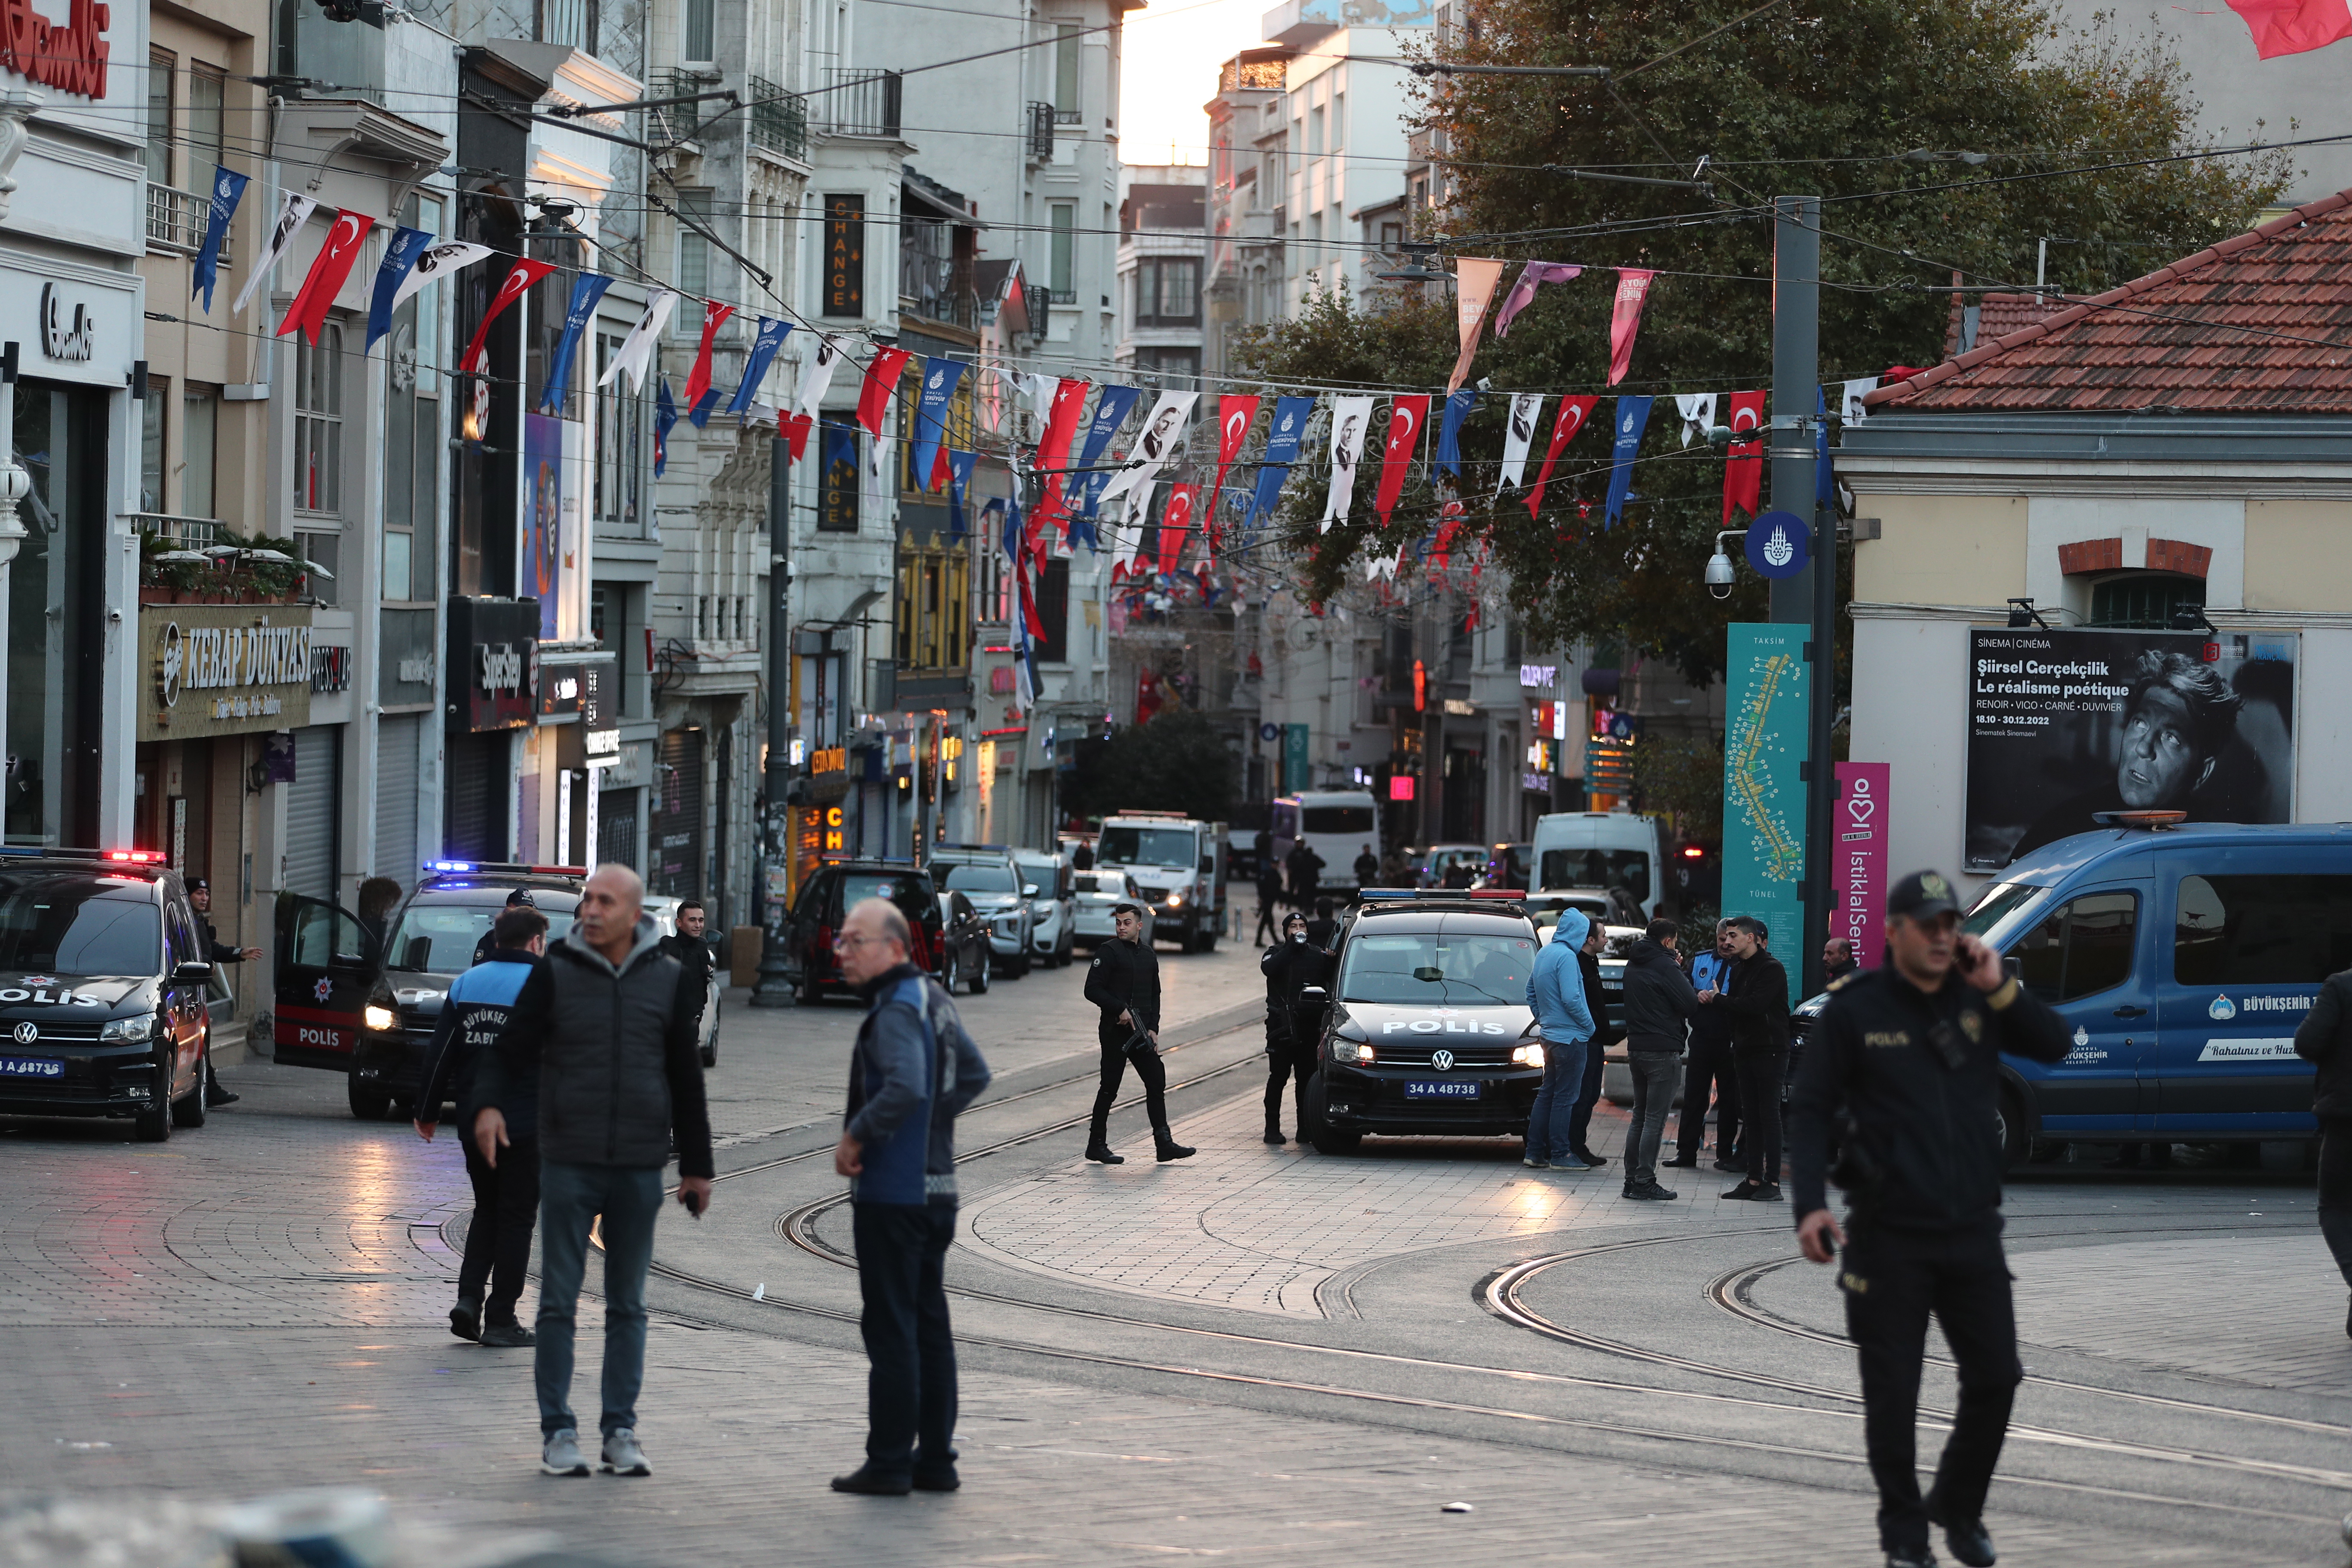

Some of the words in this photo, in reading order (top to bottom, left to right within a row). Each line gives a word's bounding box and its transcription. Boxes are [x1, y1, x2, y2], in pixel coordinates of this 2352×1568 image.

[833, 202, 847, 306] CHANGE
[41, 282, 95, 361] Bambi
[187, 628, 242, 689] KEBAP
[245, 615, 313, 686] DÜNYASI
[1978, 637, 2011, 647] SİNEMA
[2016, 638, 2051, 649] CINÉMA
[338, 648, 352, 691] LAB
[1977, 659, 2023, 677] Şiirsel
[2026, 660, 2109, 679] Gerçekçilik
[1977, 679, 1994, 693] Le
[1998, 680, 2061, 695] réalisme
[2064, 681, 2129, 700] poétique
[1976, 700, 2009, 709] RENOIR
[2015, 701, 2038, 710] VIGO
[2045, 700, 2075, 710] CARNÉ
[2082, 702, 2122, 712] DUVIVIER
[1976, 715, 1996, 724] 18.10
[2002, 716, 2049, 725] 30.12.2022
[1750, 889, 1776, 898] TÜNEL
[0, 988, 98, 1007] OLİS
[2243, 995, 2310, 1013] BÜYÜKŞEHİR
[1383, 1019, 1505, 1035] POLİS
[300, 1028, 339, 1046] POLİS
[2062, 1050, 2107, 1060] YÜKŞEHİR
[7, 1061, 15, 1071] A
[1409, 1084, 1424, 1093] 34
[1427, 1084, 1436, 1093] A
[1439, 1084, 1476, 1094] 48738
